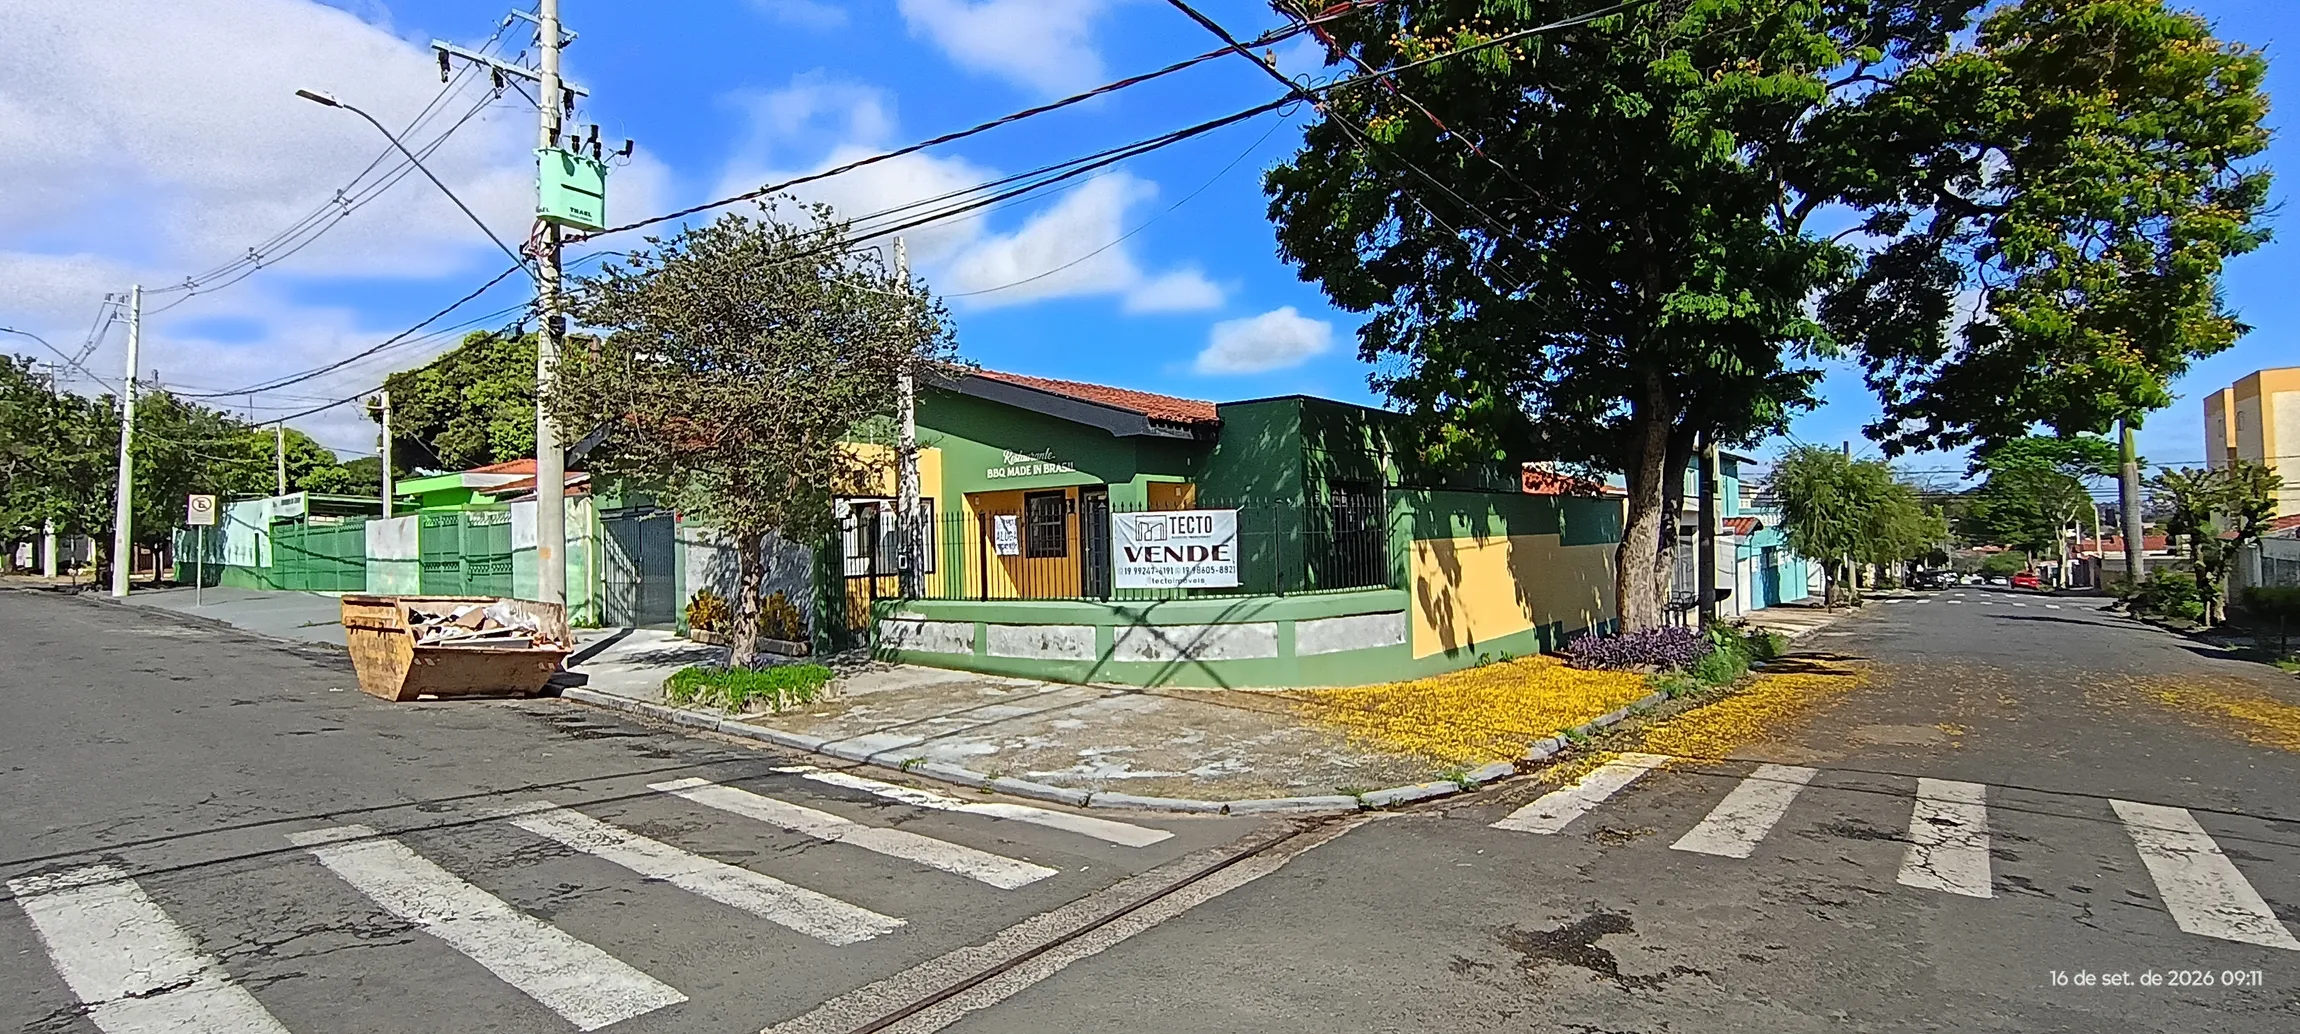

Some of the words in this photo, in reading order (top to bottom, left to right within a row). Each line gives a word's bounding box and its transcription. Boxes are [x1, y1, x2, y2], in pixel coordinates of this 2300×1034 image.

[986, 468, 1006, 478] BBQ
[1007, 465, 1032, 477] MADE
[1033, 463, 1042, 475] IN
[1043, 461, 1076, 474] BRASIL
[1169, 515, 1212, 534] TECTO
[1123, 544, 1231, 563] VENDE
[1124, 566, 1132, 575] 19
[1182, 566, 1190, 575] 19
